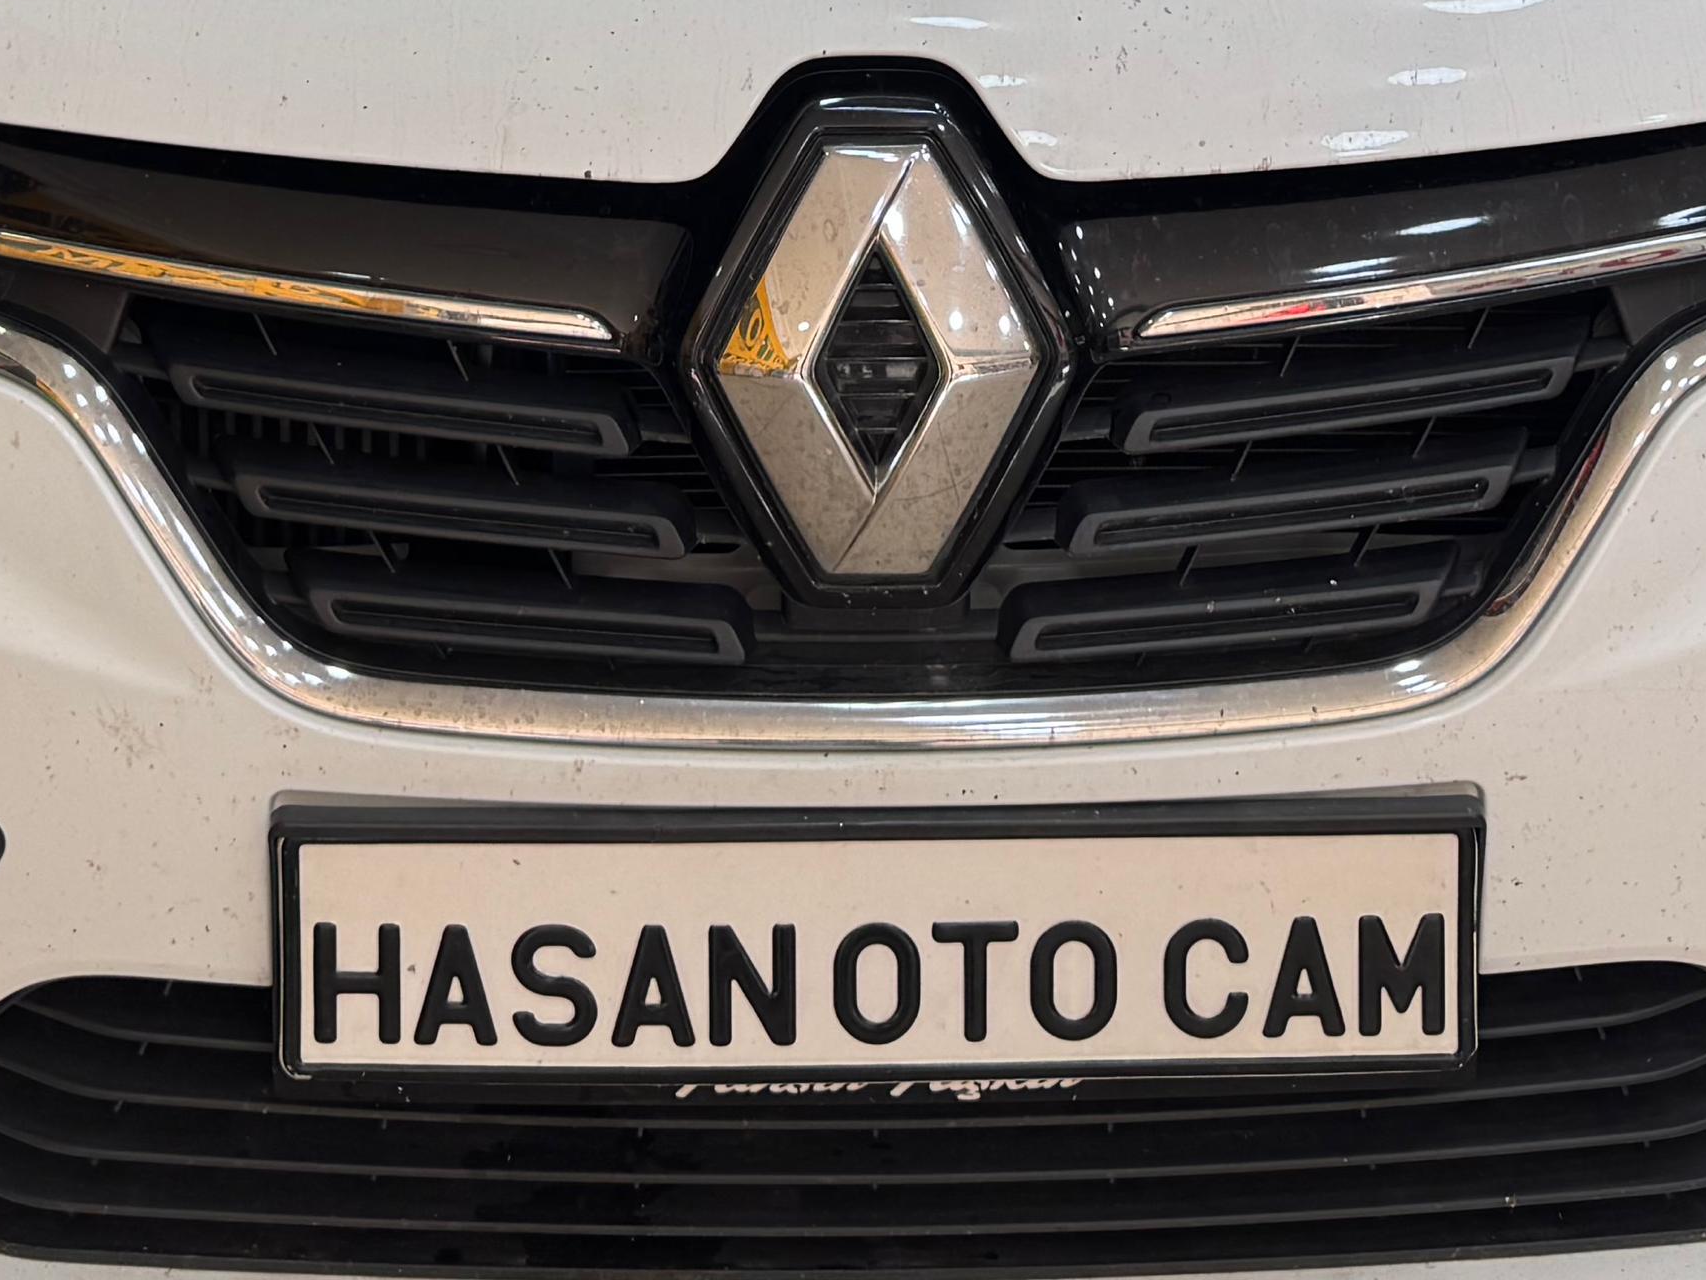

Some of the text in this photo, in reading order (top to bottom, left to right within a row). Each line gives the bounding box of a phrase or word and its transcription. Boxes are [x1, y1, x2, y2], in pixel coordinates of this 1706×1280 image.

[311, 912, 1448, 1047] HASAN OTO CAM
